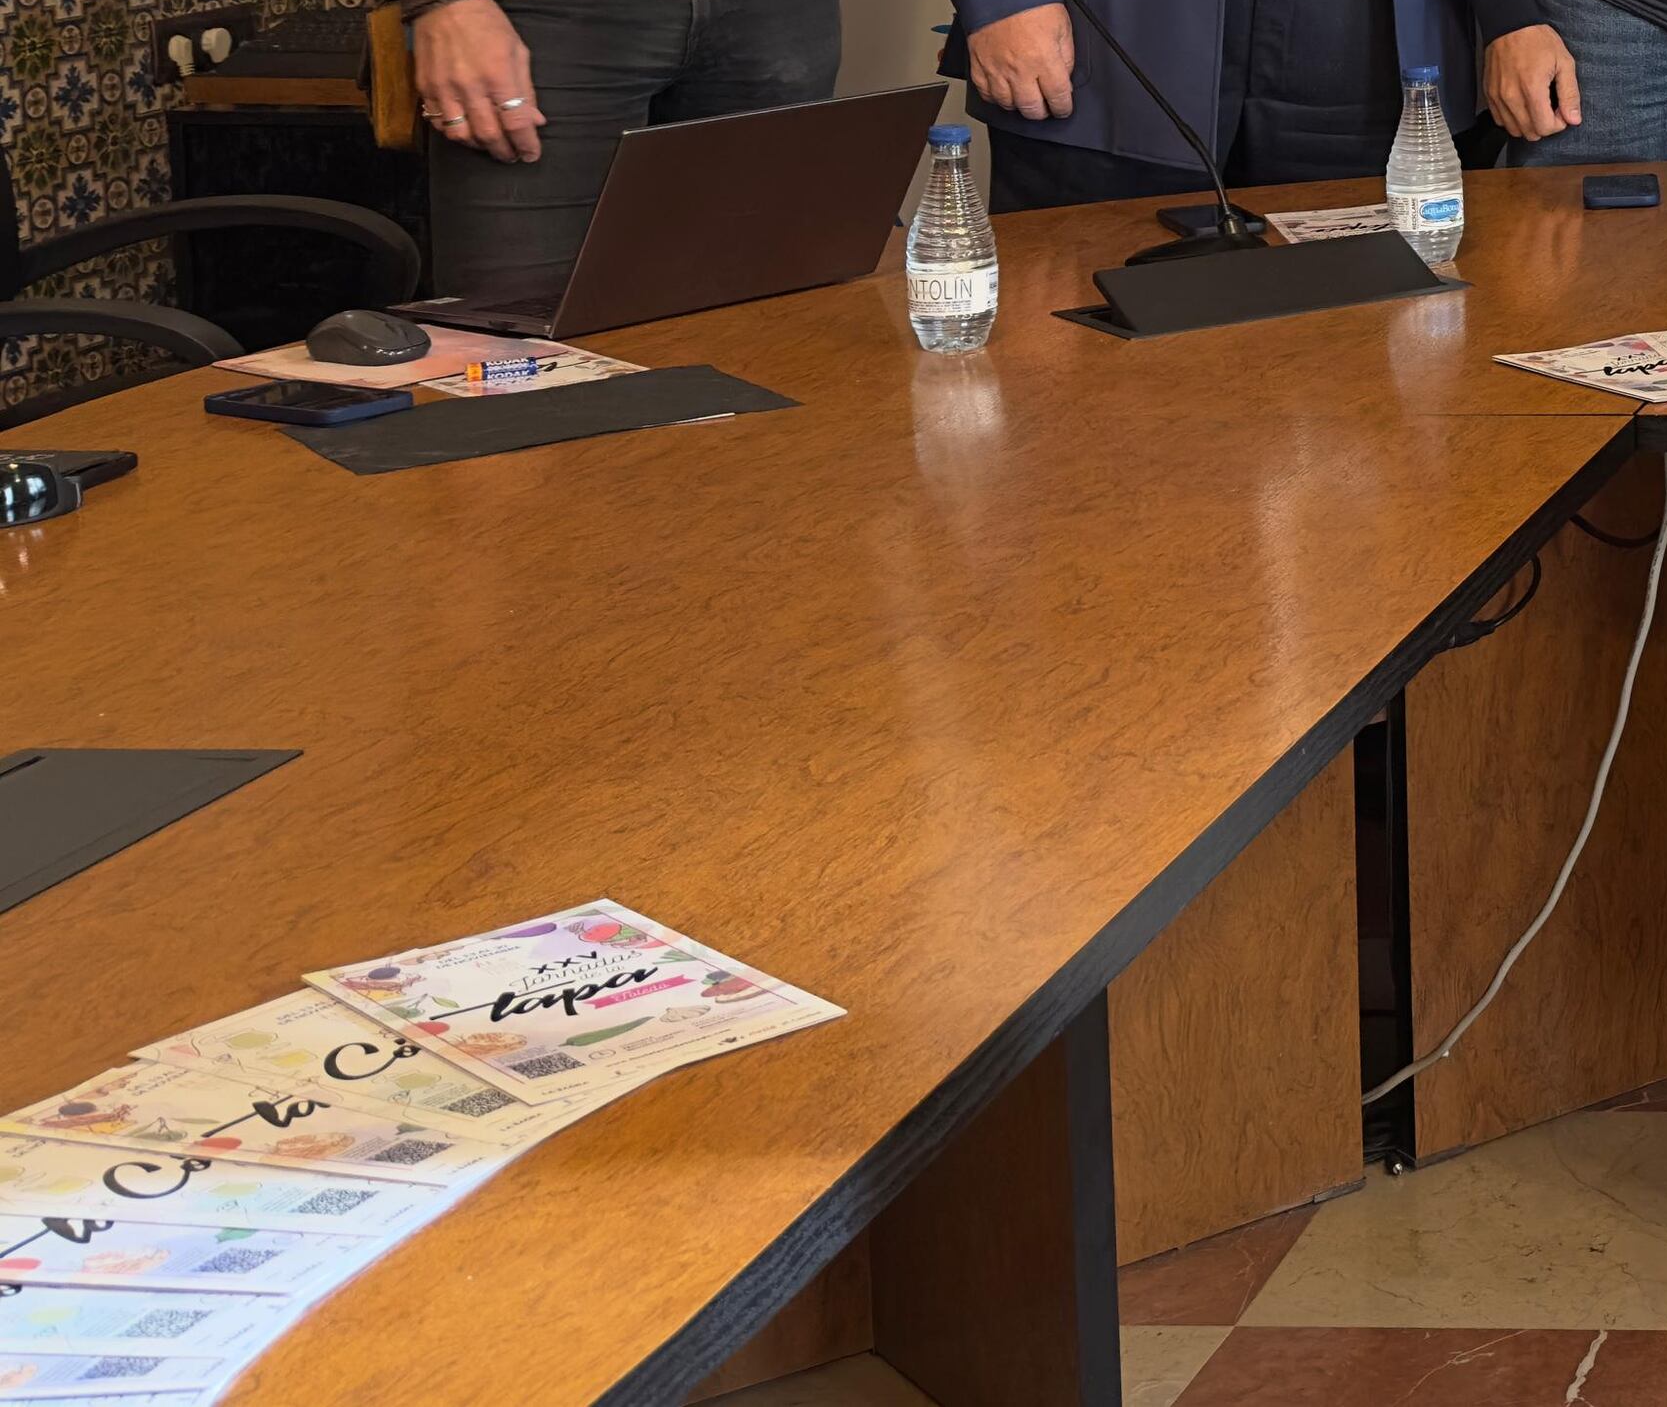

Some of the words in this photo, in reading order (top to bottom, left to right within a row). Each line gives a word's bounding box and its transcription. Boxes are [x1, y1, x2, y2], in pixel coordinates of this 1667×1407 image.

[908, 276, 973, 300] NTOLÍN
[487, 369, 530, 380] KODAK
[531, 950, 598, 975] XXV
[429, 966, 658, 1022] tapa
